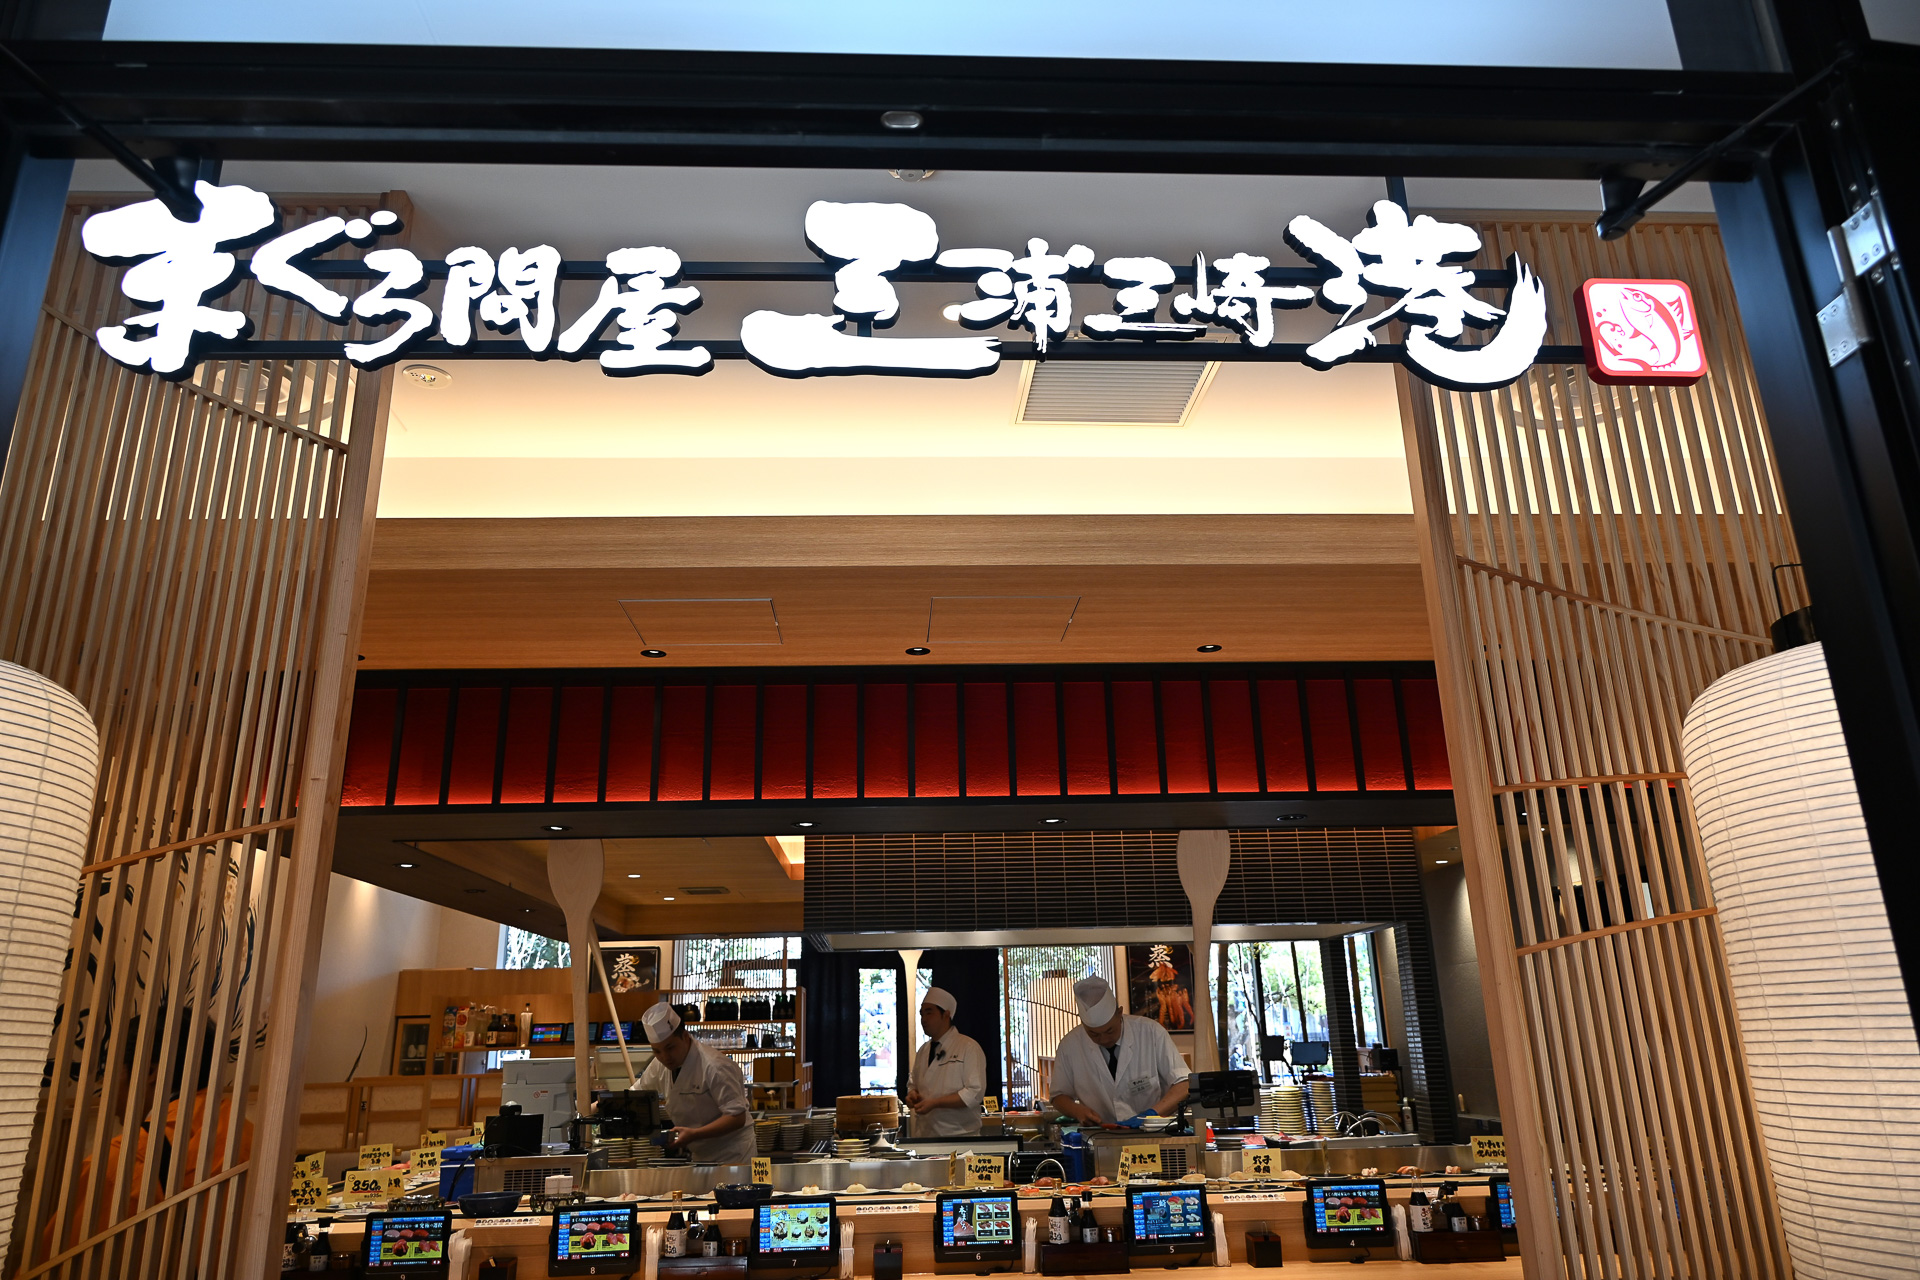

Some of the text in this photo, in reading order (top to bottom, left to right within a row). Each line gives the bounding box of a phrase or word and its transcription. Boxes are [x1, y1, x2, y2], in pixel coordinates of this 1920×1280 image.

[82, 180, 1548, 386] まぐろ問屋 三浦三崎港
[1148, 944, 1173, 969] 蒸
[611, 953, 639, 983] 蒸
[1350, 1239, 1355, 1247] 4
[976, 1252, 981, 1260] 6
[590, 1266, 596, 1274] 8
